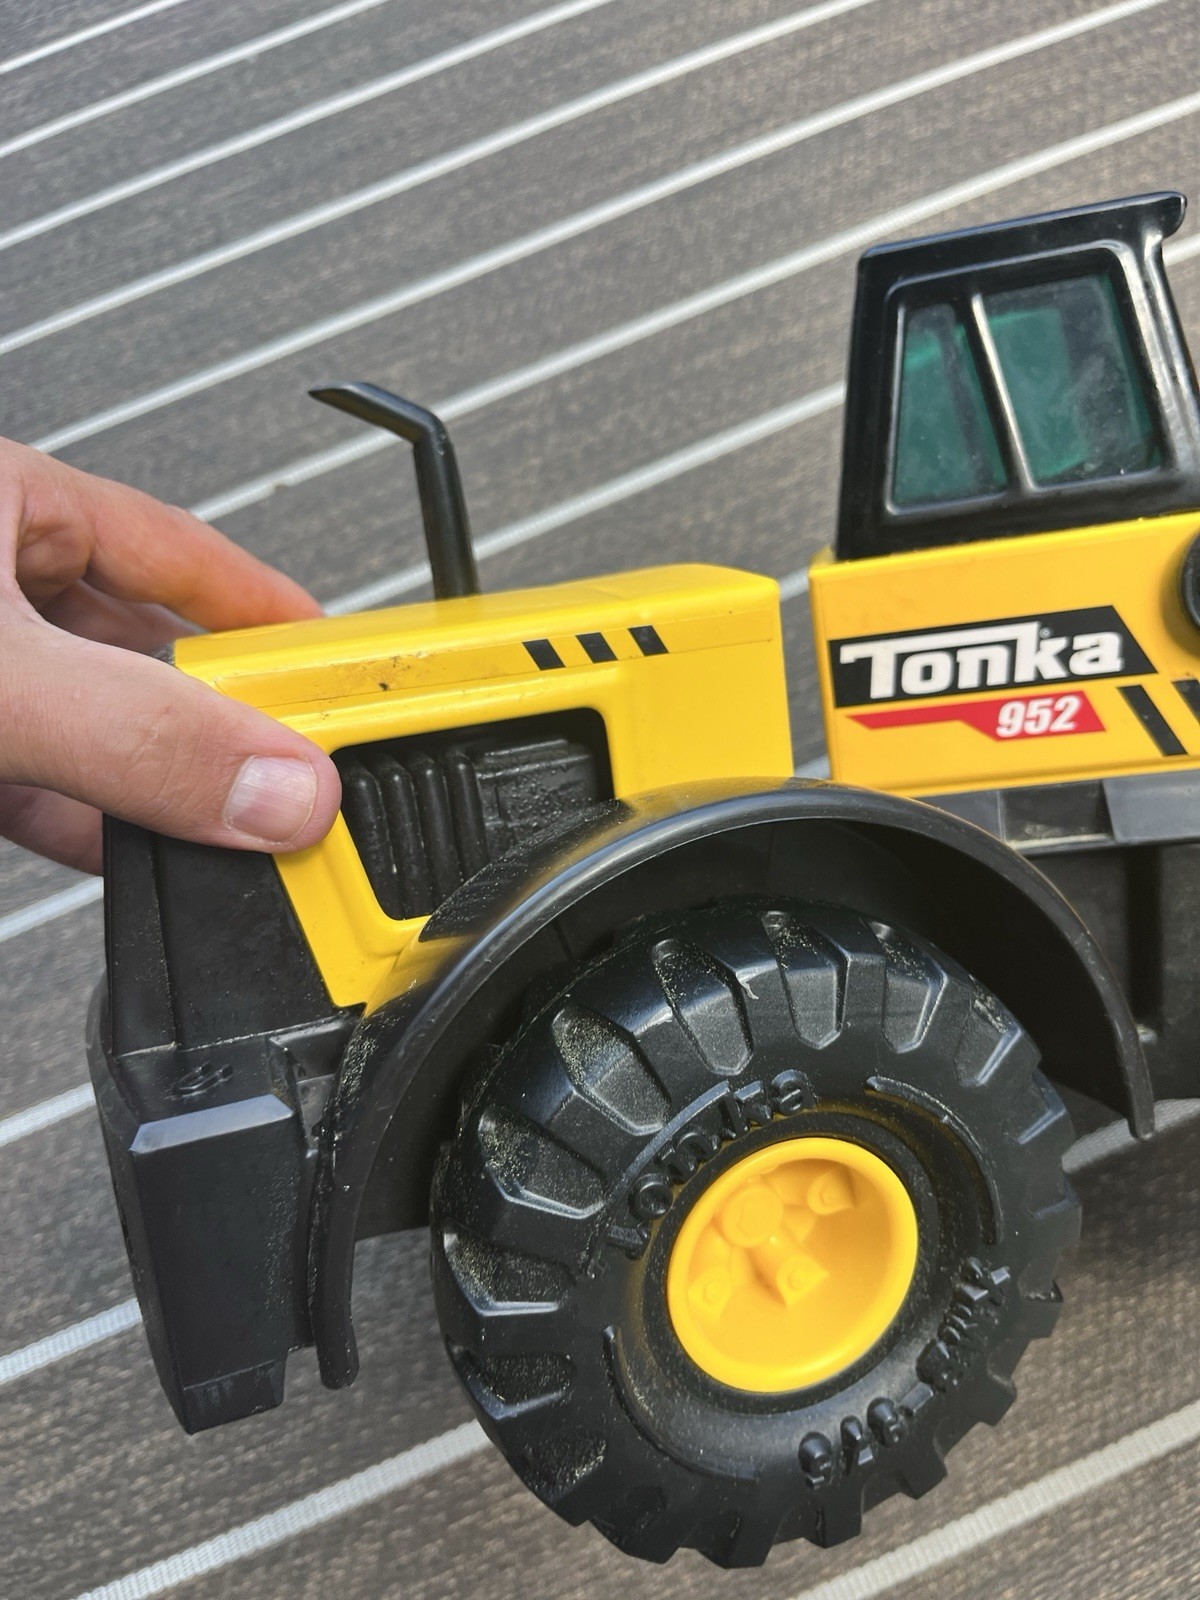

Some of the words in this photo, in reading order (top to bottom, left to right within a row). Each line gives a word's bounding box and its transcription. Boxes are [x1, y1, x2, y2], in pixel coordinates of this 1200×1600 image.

[839, 620, 1124, 699] Tonka
[995, 694, 1081, 738] 952
[586, 1068, 818, 1277] Tonka
